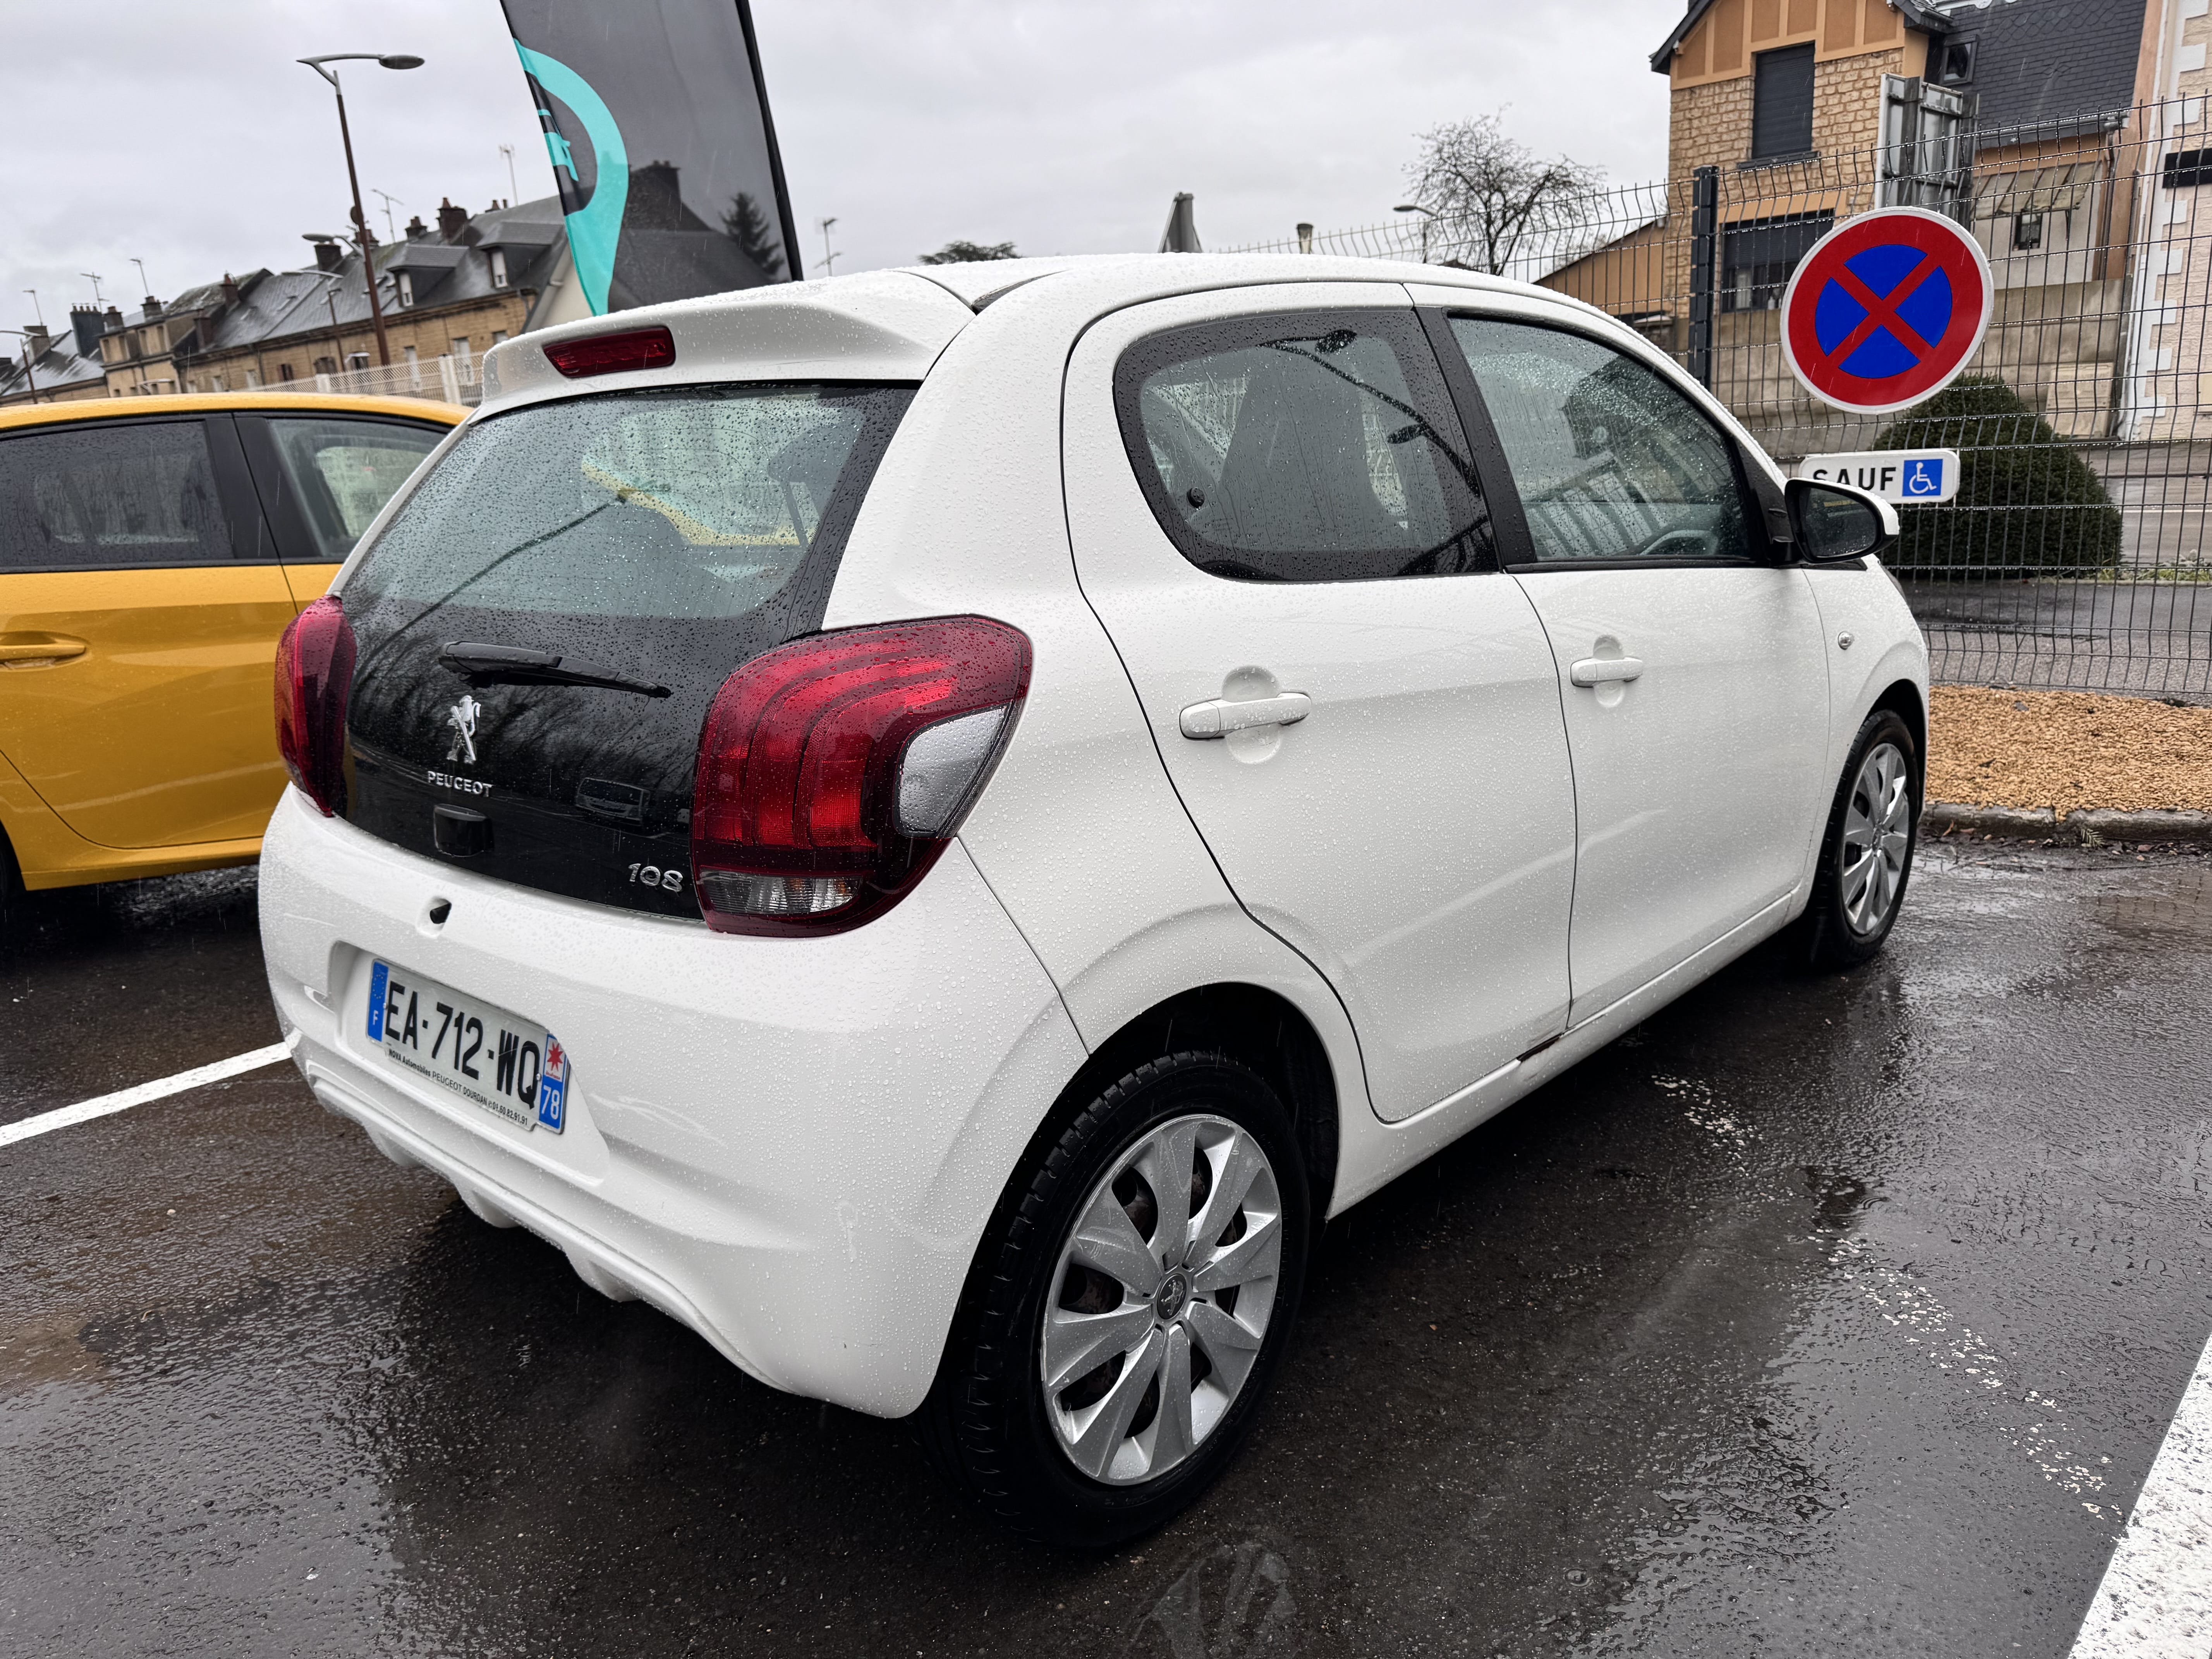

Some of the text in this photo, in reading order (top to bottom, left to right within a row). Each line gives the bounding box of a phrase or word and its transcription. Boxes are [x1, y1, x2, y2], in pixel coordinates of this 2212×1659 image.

[428, 770, 493, 797] PEUGEOT
[628, 863, 683, 892] 108
[372, 1010, 378, 1025] F
[385, 981, 540, 1109] EA-712-WQ
[389, 1049, 402, 1062] NOVA
[402, 1056, 431, 1077] Automobiles
[432, 1071, 463, 1092] PEUGEOT
[463, 1087, 488, 1106] DOURDAN
[541, 1084, 560, 1120] 78
